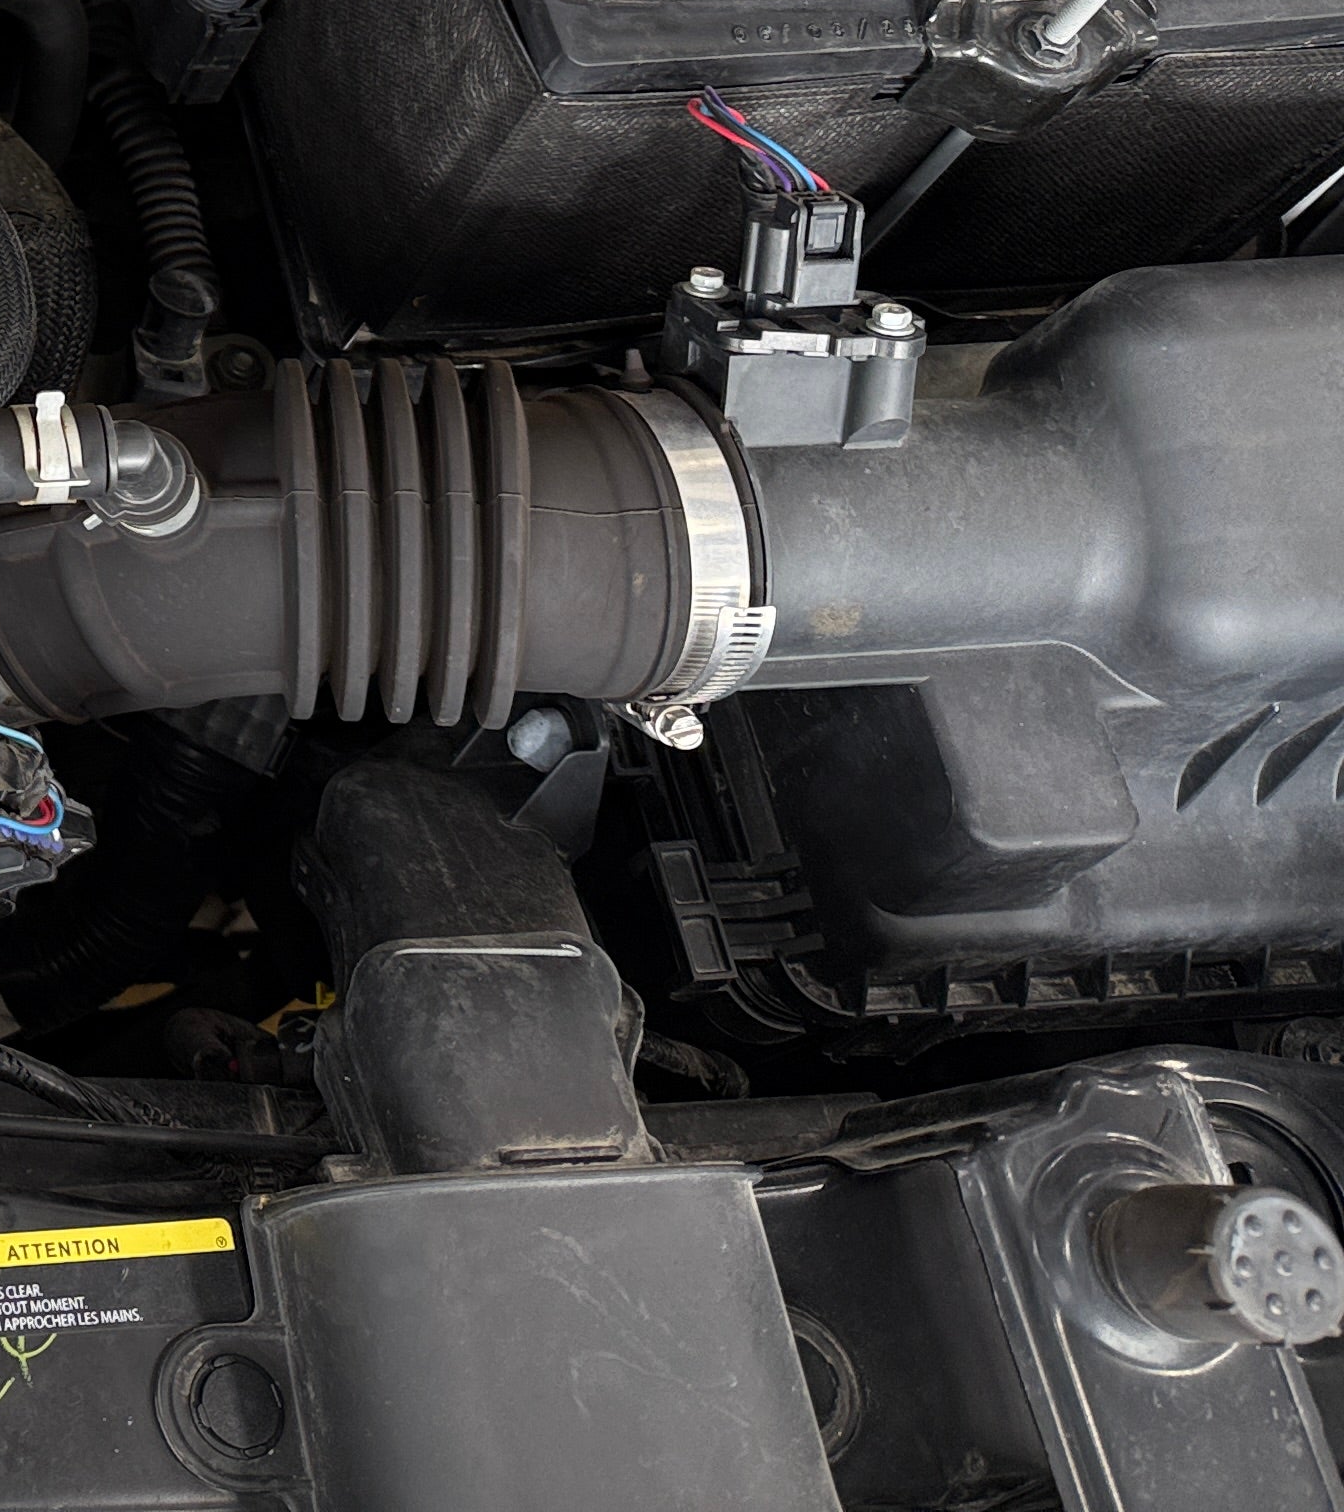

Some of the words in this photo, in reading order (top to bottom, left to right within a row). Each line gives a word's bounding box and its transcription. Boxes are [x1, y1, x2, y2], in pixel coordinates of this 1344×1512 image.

[6, 1236, 121, 1262] ATTENTION
[5, 1282, 44, 1300] CLEAR.
[29, 1295, 90, 1314] MOMENT.
[3, 1312, 77, 1332] APPROCHER
[77, 1309, 100, 1326] LES
[99, 1307, 145, 1326] MAINS.
